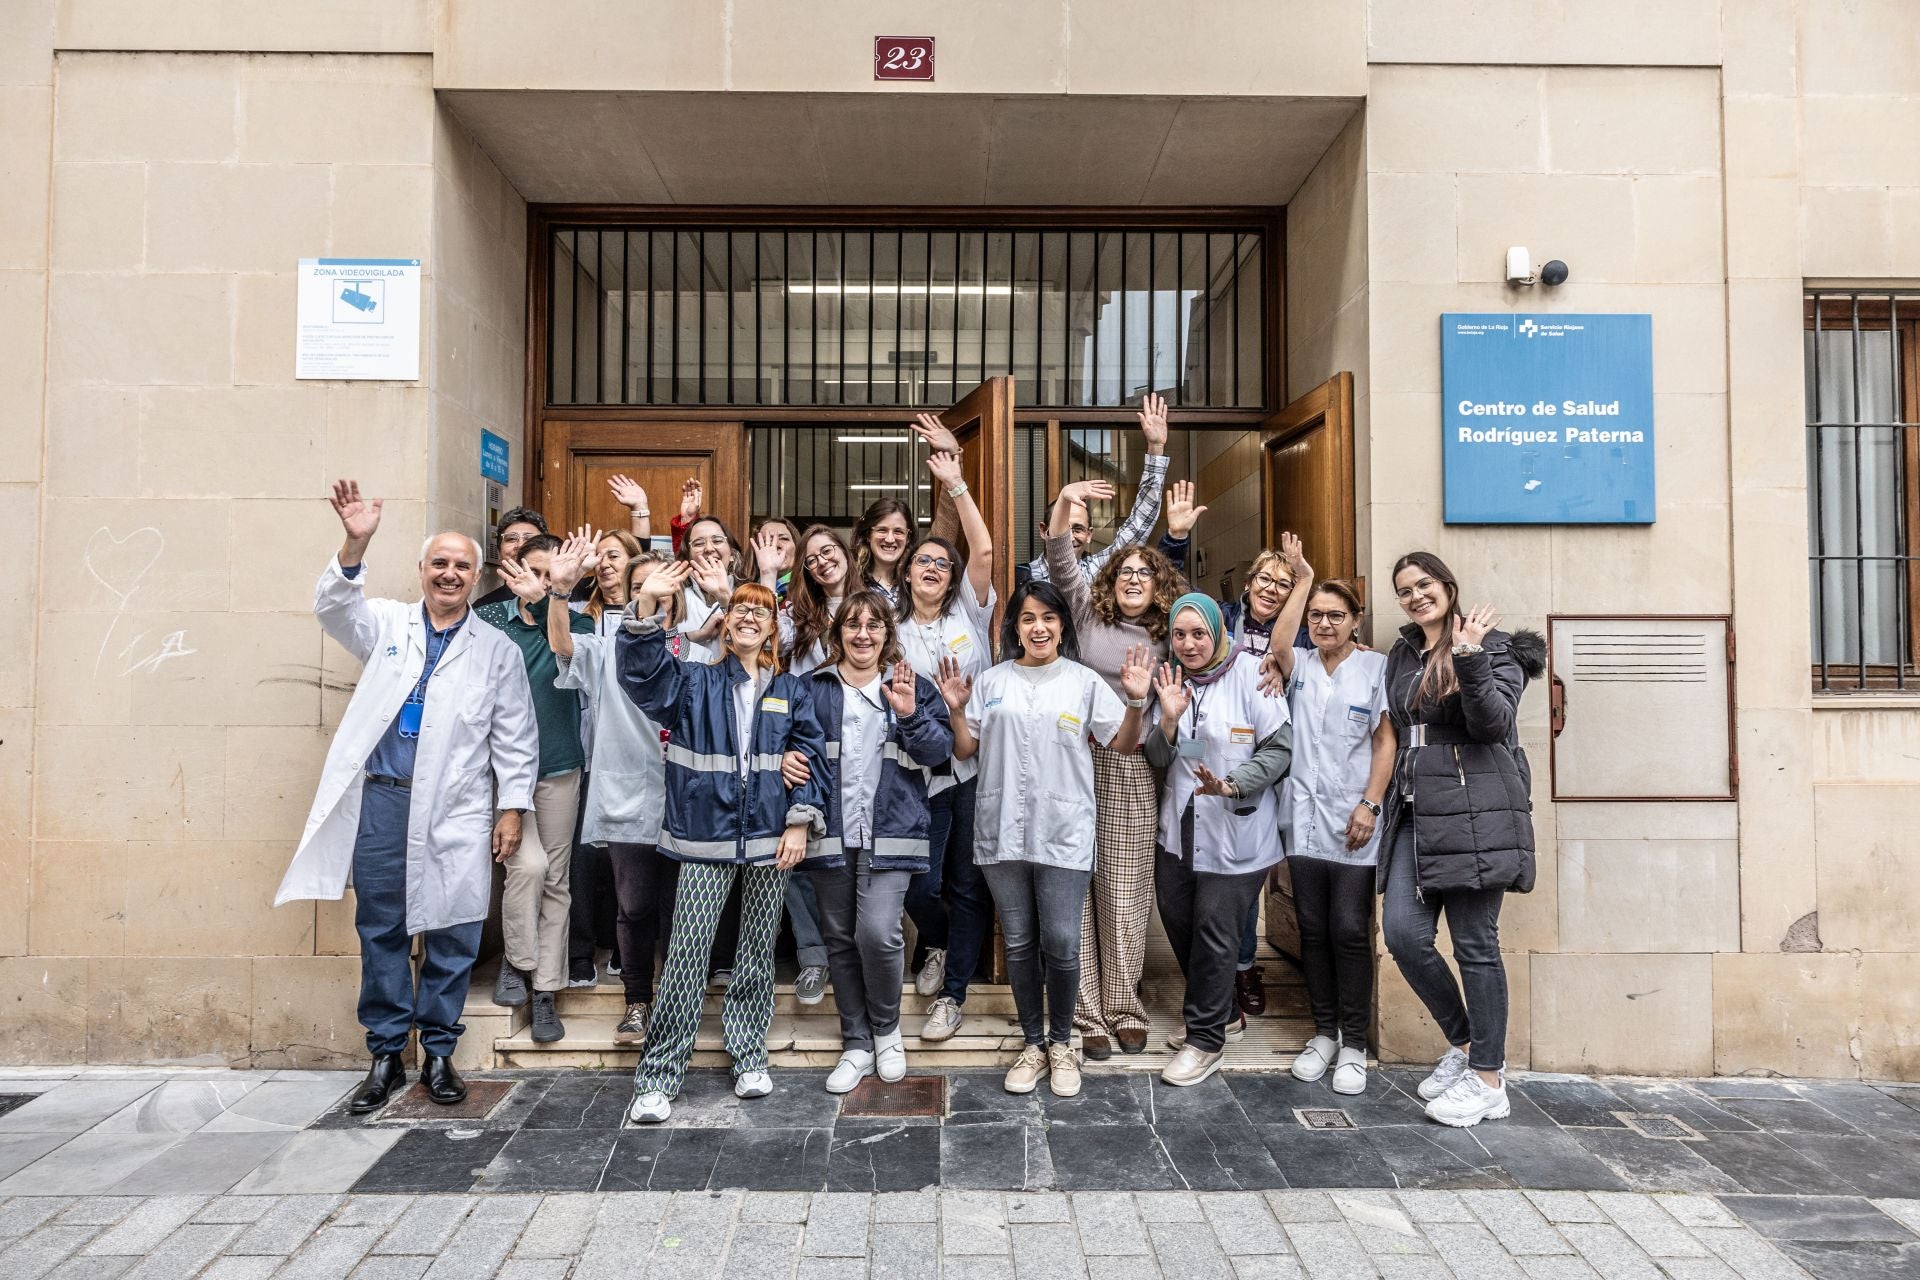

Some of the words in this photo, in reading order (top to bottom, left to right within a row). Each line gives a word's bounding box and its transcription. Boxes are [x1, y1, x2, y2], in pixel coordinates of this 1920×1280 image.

[883, 46, 926, 70] 23
[313, 268, 337, 276] ZONA
[340, 268, 405, 277] VIDEOVIGILADA
[1458, 400, 1526, 416] Centro
[1532, 400, 1557, 416] de
[1562, 400, 1620, 416] Salud
[1458, 426, 1558, 446] Rodríguez
[1565, 427, 1645, 443] Paterna
